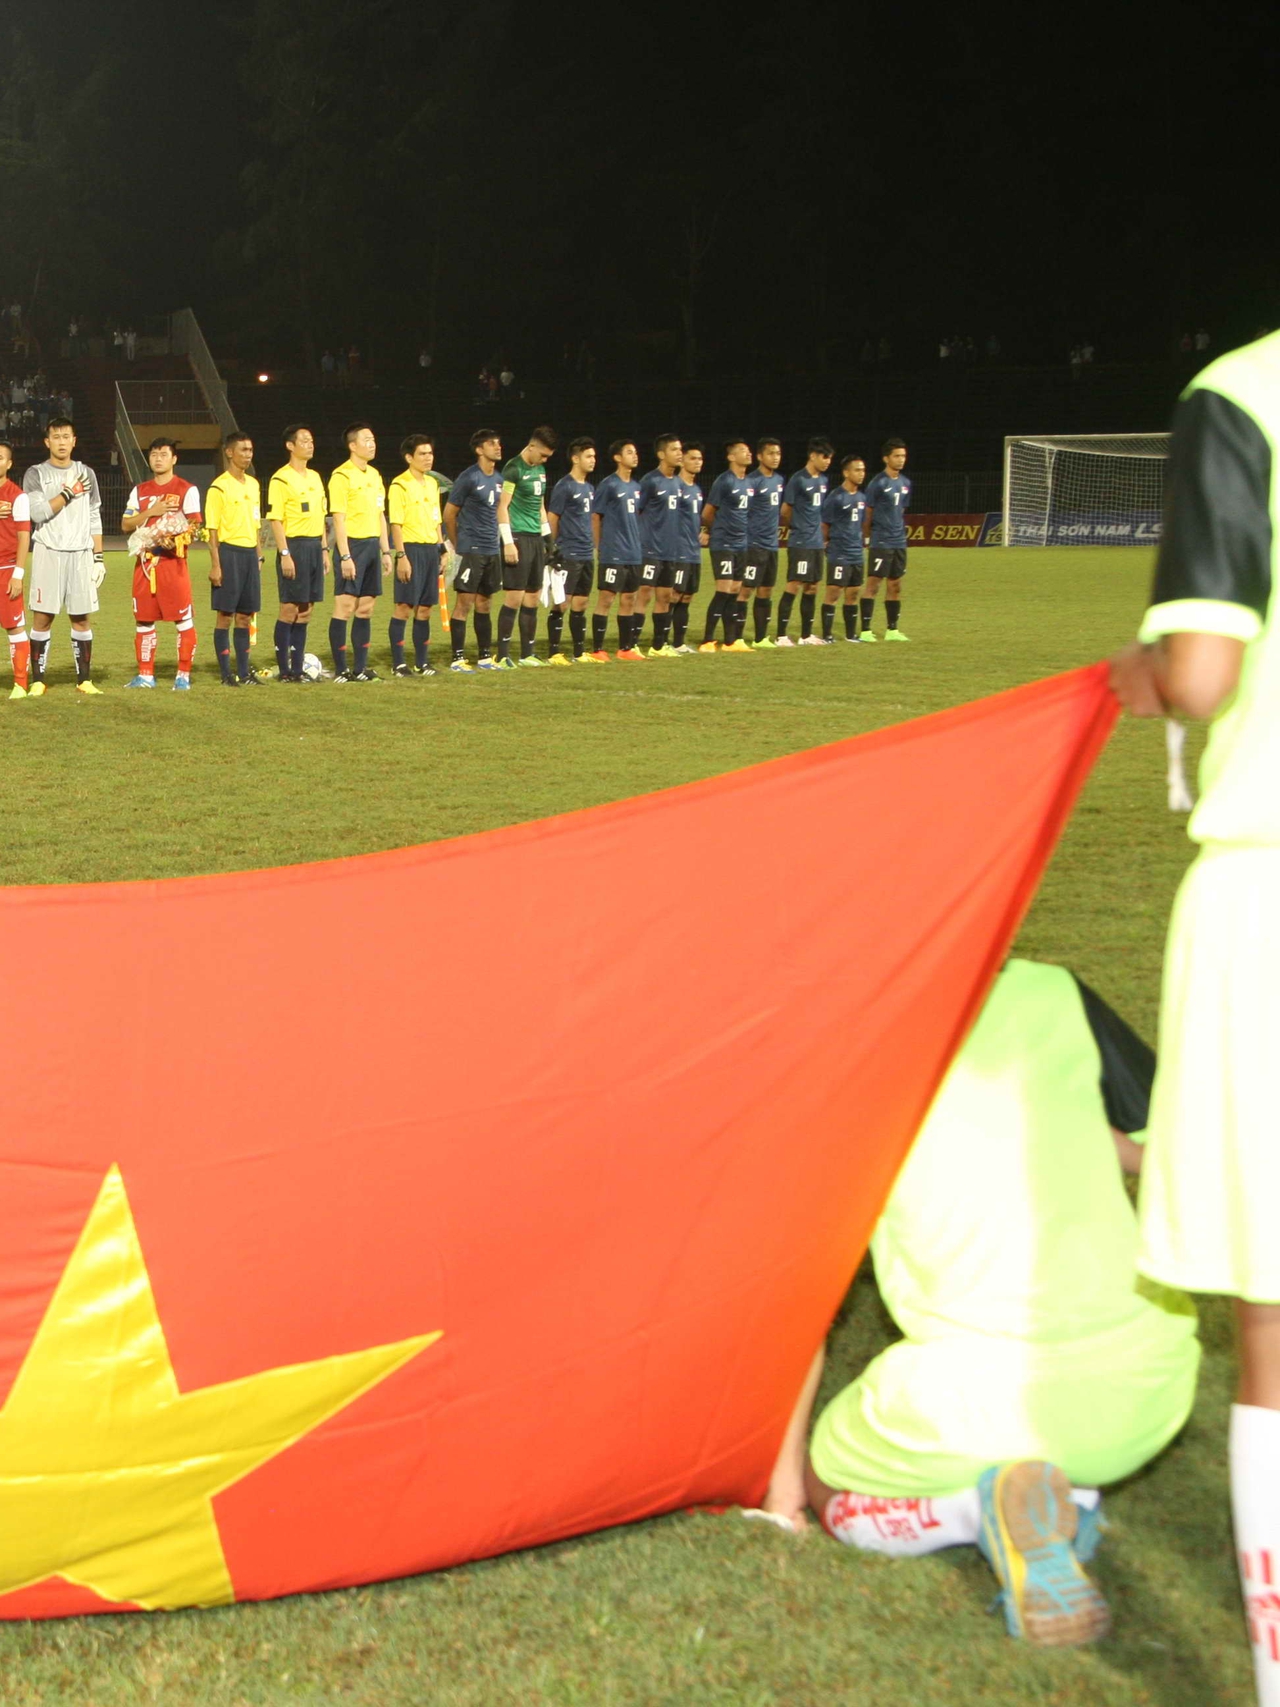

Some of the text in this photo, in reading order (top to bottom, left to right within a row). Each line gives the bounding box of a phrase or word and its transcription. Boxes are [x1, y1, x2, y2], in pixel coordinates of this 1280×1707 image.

[488, 490, 495, 506] 4
[738, 494, 748, 509] 21
[930, 525, 981, 540] SEN
[1094, 524, 1133, 536] NAM
[643, 564, 656, 580] 15
[721, 560, 733, 576] 21
[744, 565, 757, 580] 13
[797, 560, 809, 575] 10
[874, 558, 884, 572] 7
[460, 567, 472, 584] 4
[605, 567, 618, 584] 16
[674, 569, 685, 585] 11
[834, 566, 843, 580] 6
[36, 587, 42, 604] 1
